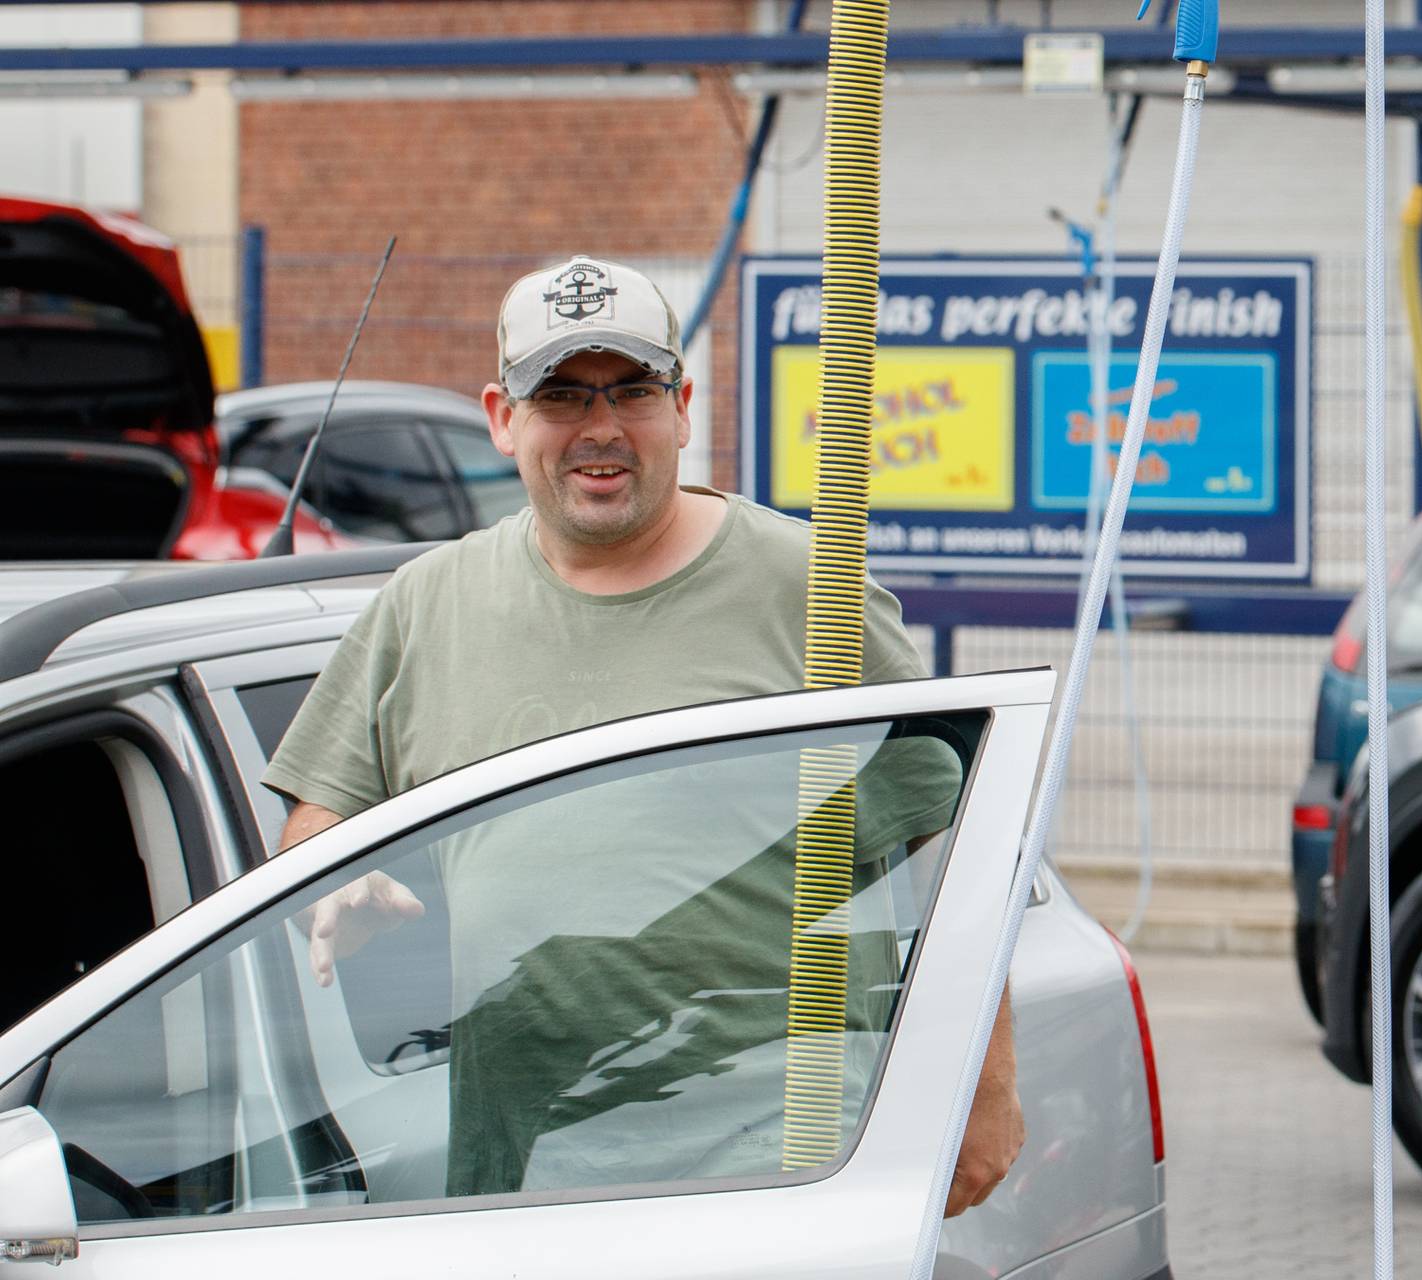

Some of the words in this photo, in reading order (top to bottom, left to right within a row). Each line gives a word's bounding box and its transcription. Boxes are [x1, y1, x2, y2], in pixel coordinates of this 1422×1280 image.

[561, 295, 599, 304] ORIGINAL
[876, 292, 936, 336] as
[1165, 287, 1283, 338] inish
